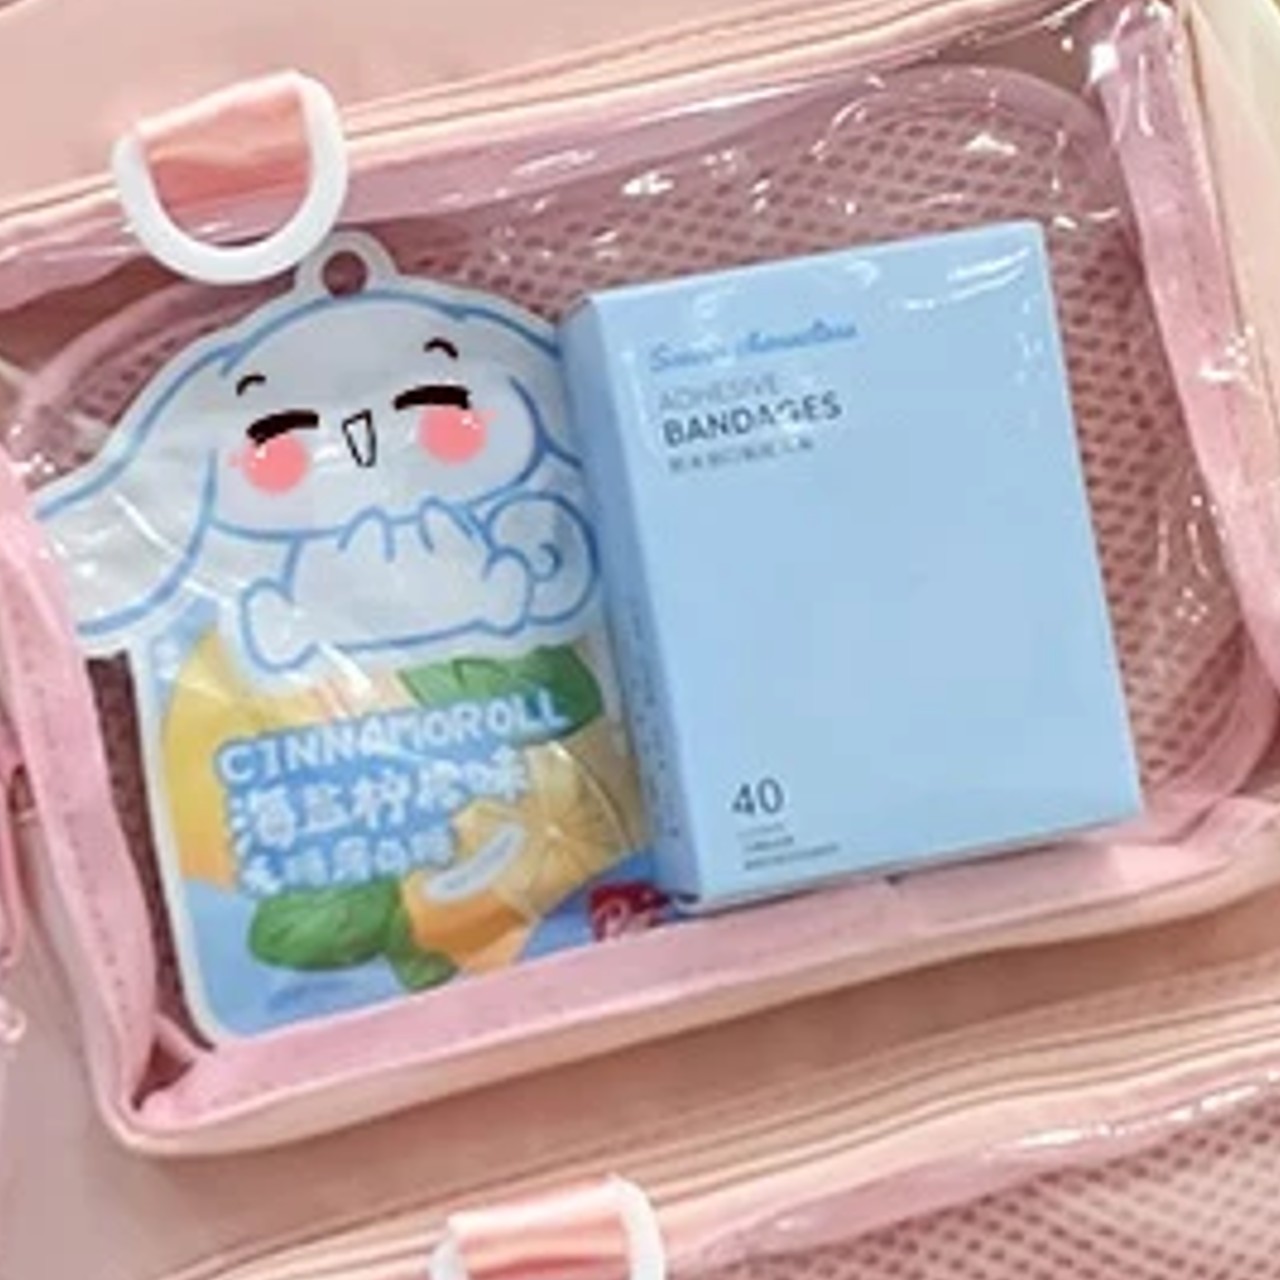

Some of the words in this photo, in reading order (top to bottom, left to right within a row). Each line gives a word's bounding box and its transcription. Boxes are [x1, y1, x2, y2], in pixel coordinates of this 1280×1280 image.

[663, 389, 843, 448] BANDAGES
[220, 690, 568, 782] CINNAMOROLL
[731, 777, 784, 814] 40
